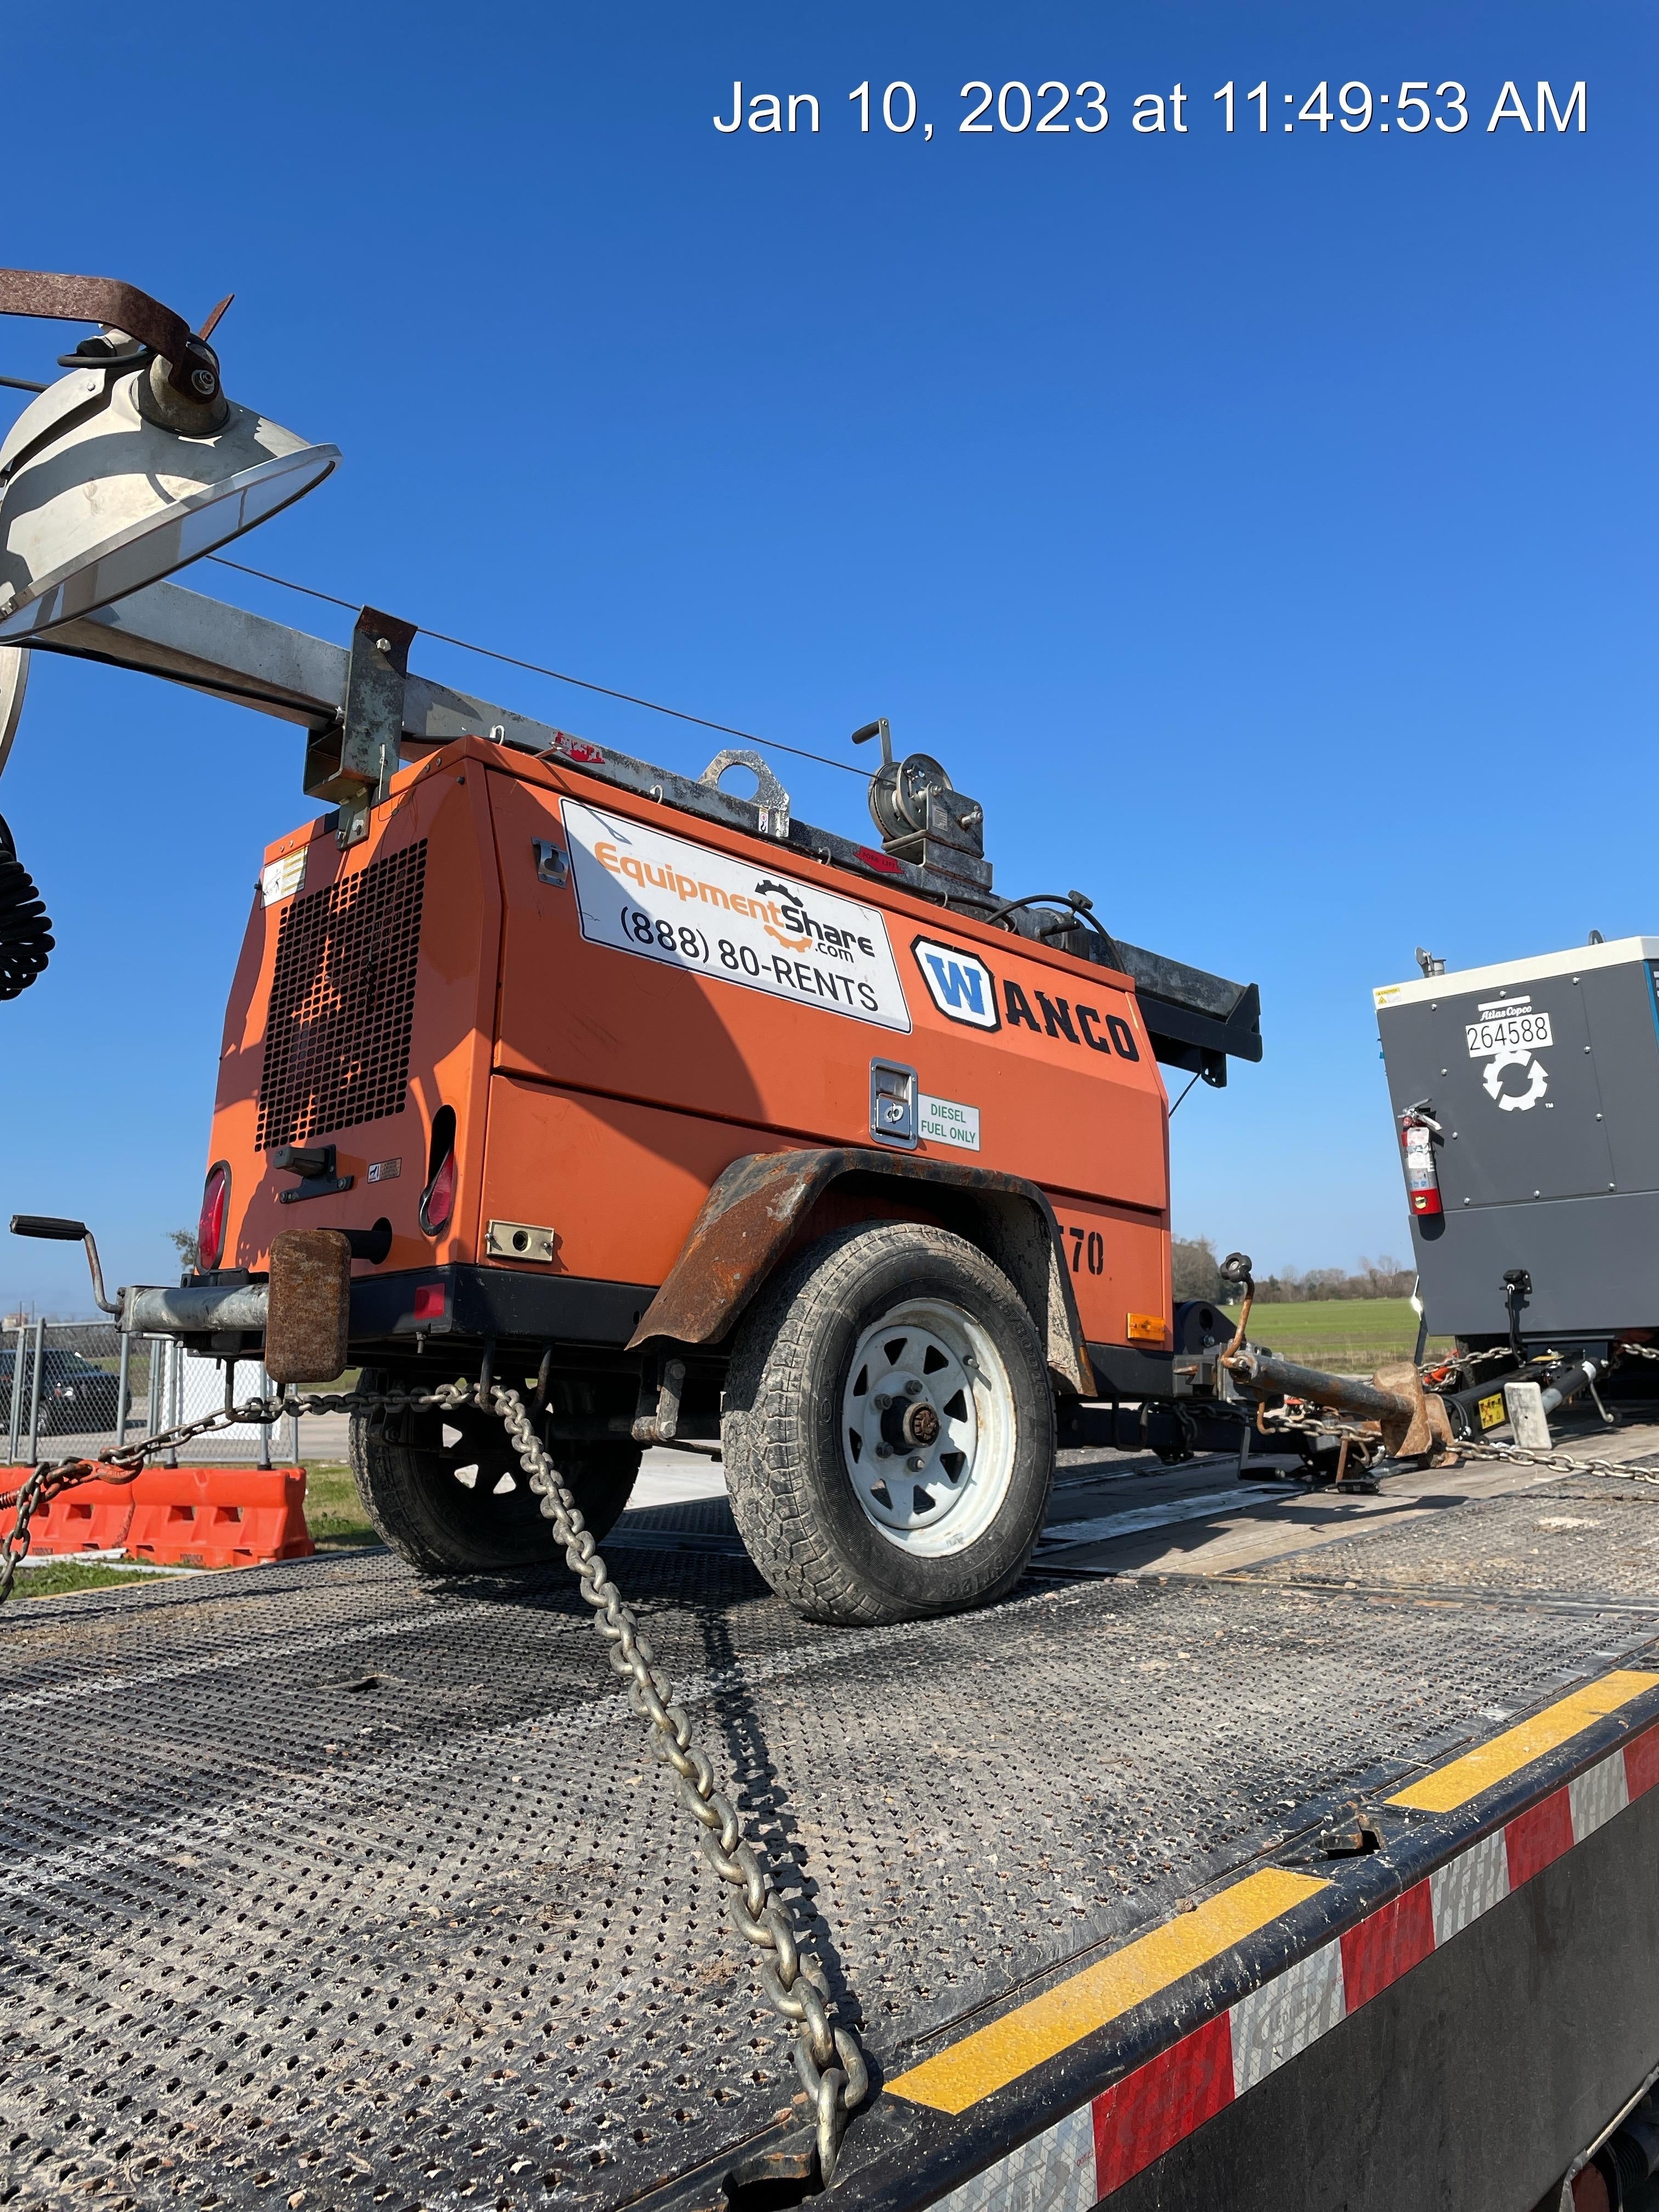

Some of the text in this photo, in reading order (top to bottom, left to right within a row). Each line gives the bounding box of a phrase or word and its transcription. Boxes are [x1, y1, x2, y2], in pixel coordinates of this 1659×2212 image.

[862, 851, 895, 869] FORK LIFT
[595, 842, 876, 958] EquipmentShare
[621, 906, 878, 1012] (888) 80-RENTS
[815, 942, 854, 963] .com
[926, 953, 1140, 1062] WANCO
[1480, 1005, 1532, 1021] Atlas Copco
[1467, 1017, 1548, 1051] 264588
[931, 1103, 966, 1123] DIESEL
[921, 1120, 975, 1144] FUEL ONLY
[1058, 1225, 1104, 1276] 70
